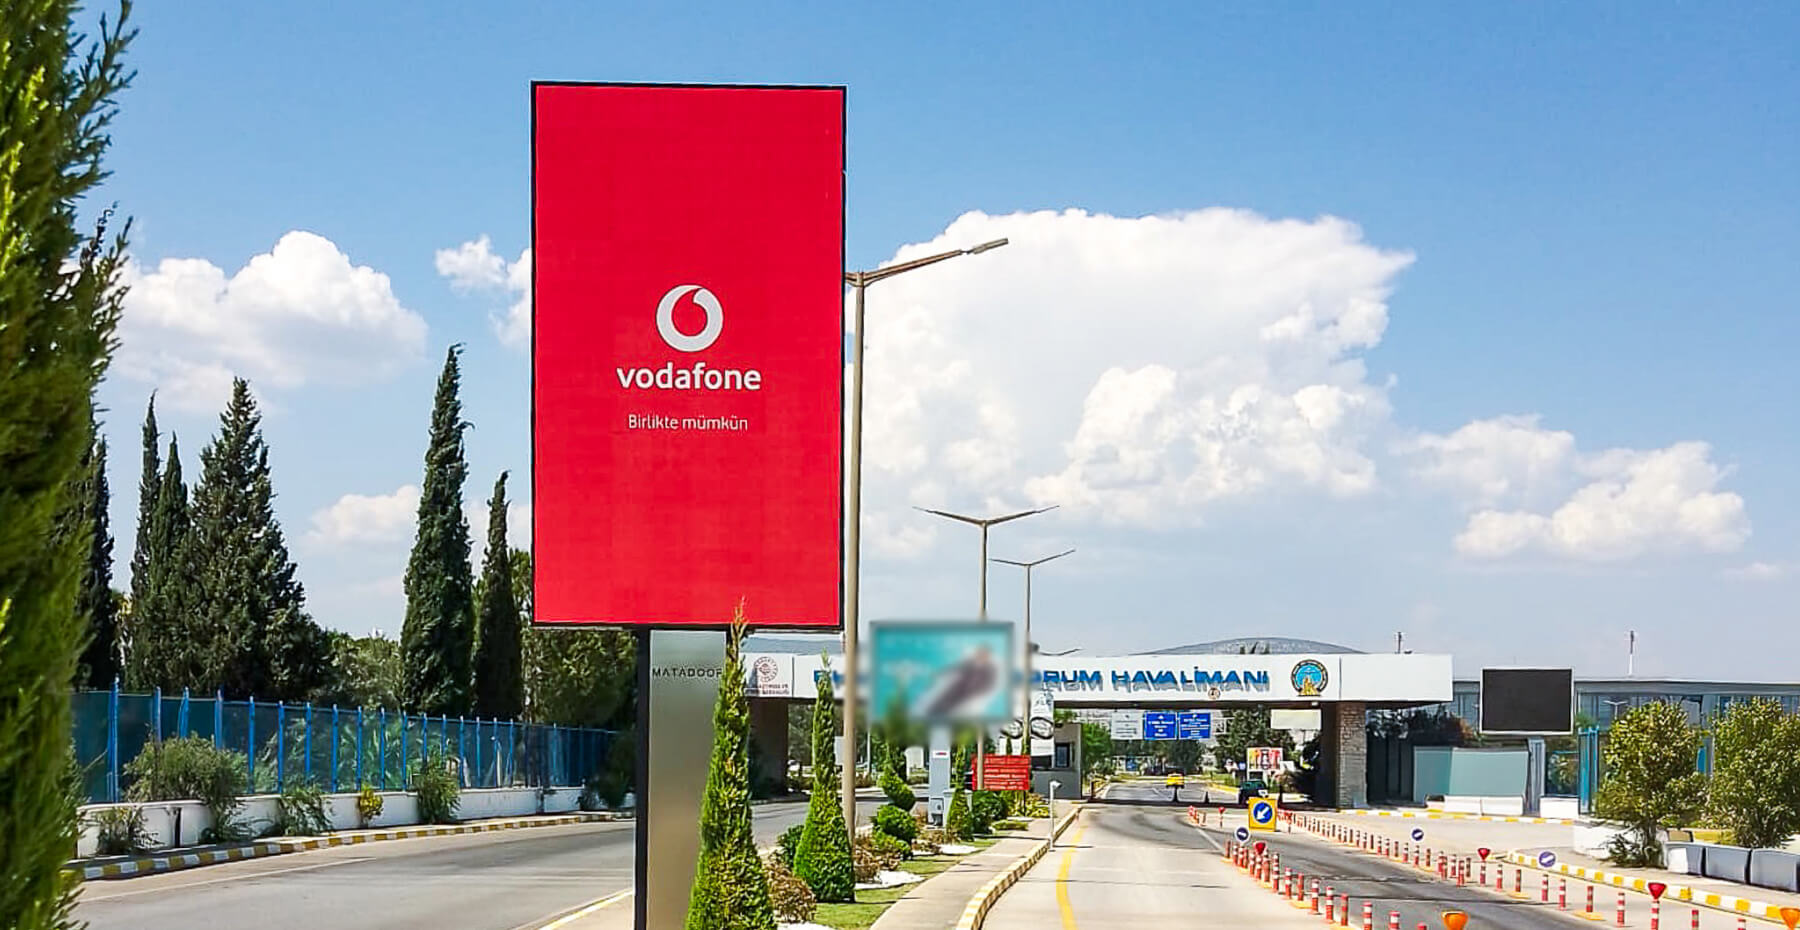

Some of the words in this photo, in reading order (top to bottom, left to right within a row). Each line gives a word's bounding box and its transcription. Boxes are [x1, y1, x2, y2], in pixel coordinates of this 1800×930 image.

[616, 361, 761, 390] vodafone
[628, 413, 679, 430] Birlikte
[682, 413, 748, 431] mümkün
[1032, 669, 1103, 688] RUM
[1111, 665, 1270, 688] HAVALİMANI
